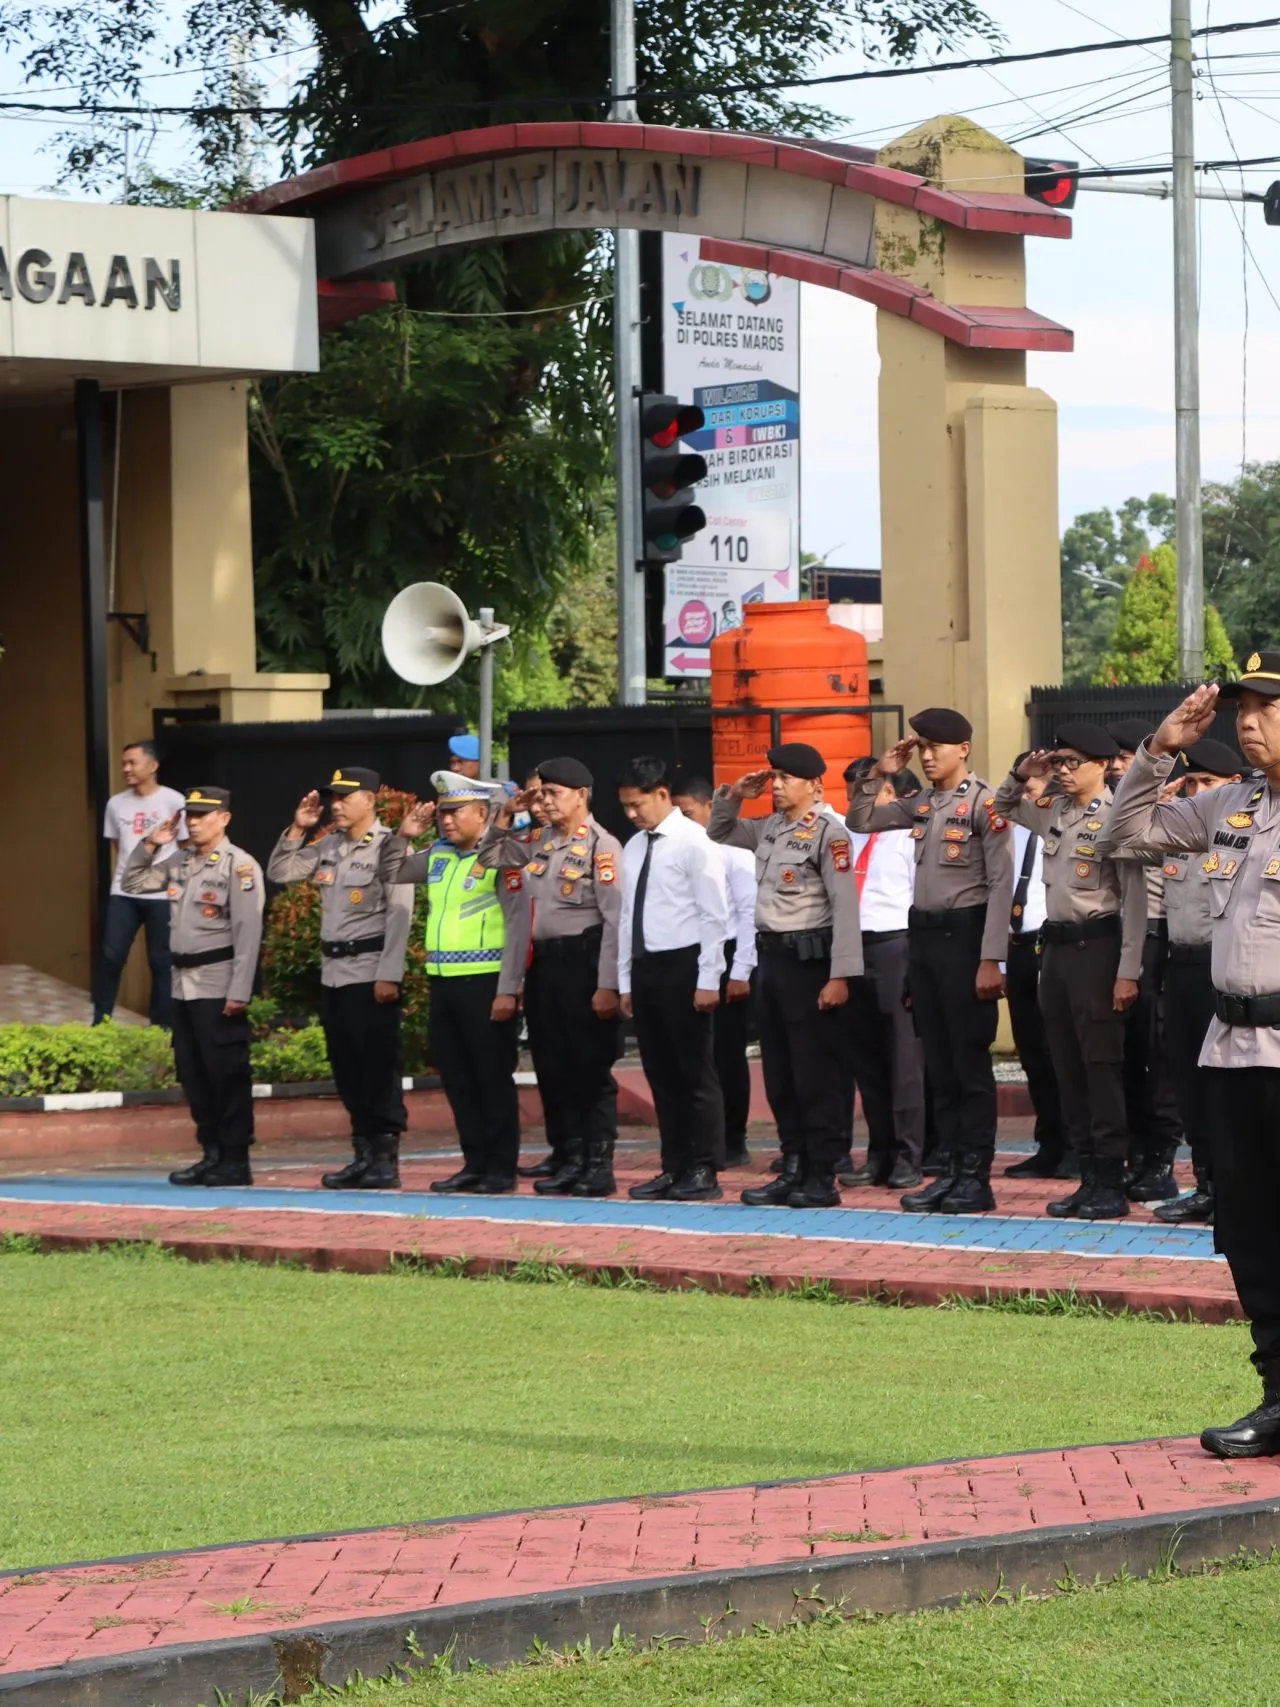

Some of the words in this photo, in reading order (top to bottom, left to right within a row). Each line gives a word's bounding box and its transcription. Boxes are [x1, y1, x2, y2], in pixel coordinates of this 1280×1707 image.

[560, 160, 703, 217] JALAN
[677, 310, 733, 328] SELAMAT
[737, 315, 784, 333] DATANG
[677, 328, 689, 344] DI
[693, 330, 739, 349] POLRES
[742, 334, 784, 351] MAROS
[711, 410, 735, 425] DARI
[740, 404, 786, 420] KORUPSI
[752, 424, 787, 443] (WBK)
[728, 443, 793, 466] BIROKRASI
[723, 466, 776, 485] MELAYANI
[709, 534, 749, 563] 110
[786, 841, 812, 851] POLRI
